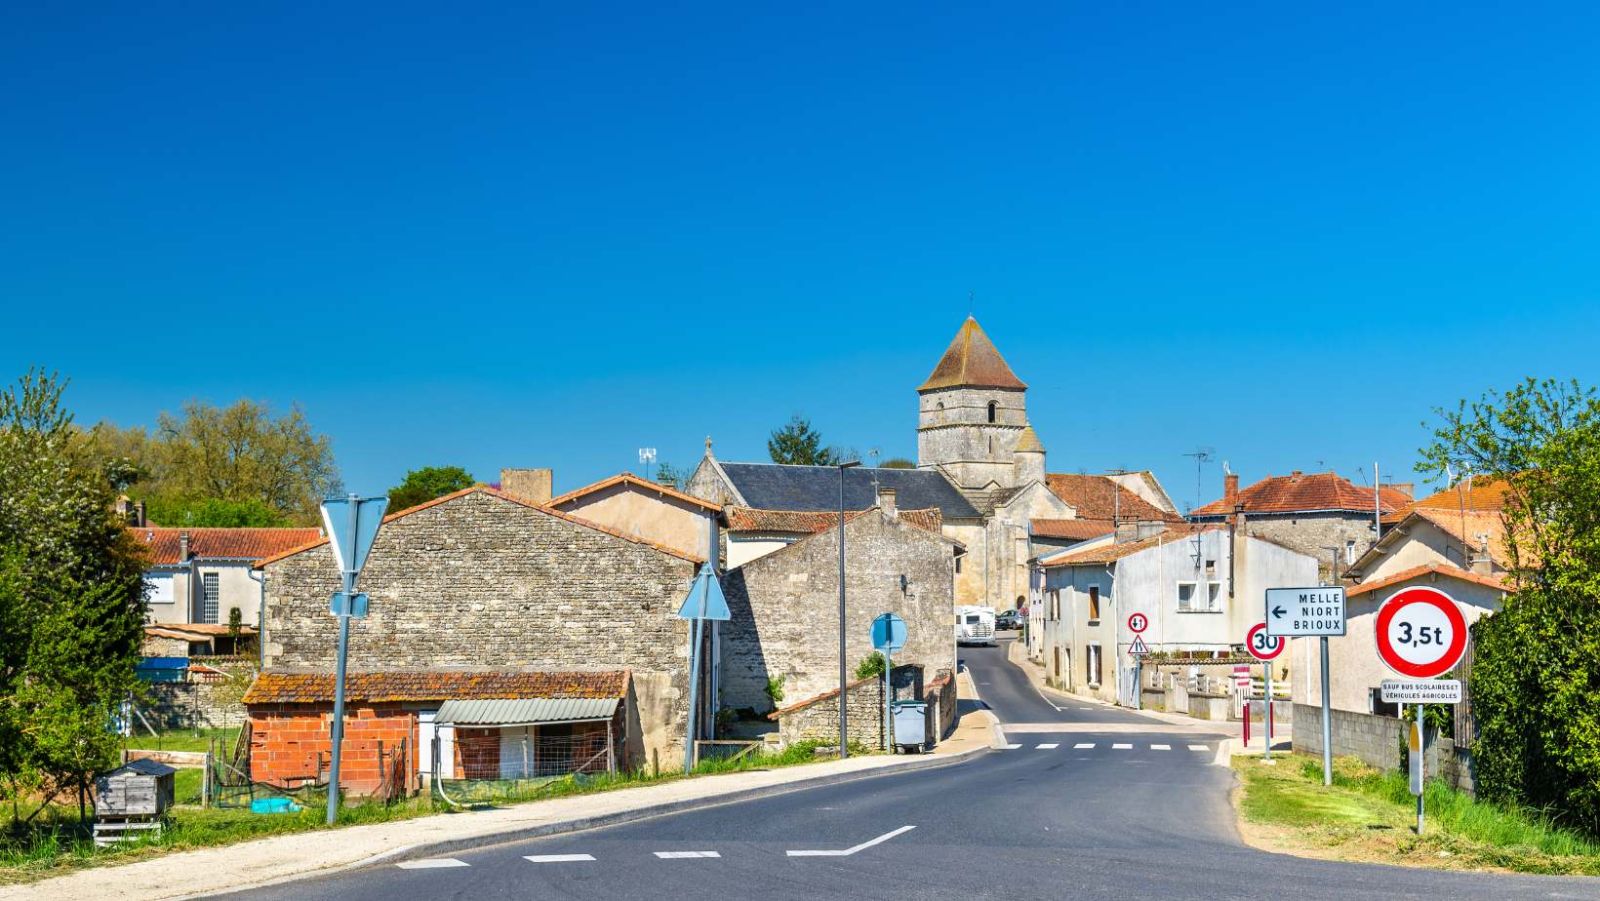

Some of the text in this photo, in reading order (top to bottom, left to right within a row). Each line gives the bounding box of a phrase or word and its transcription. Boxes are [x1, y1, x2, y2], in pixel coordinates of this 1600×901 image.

[1299, 594, 1339, 603] MELLE
[1302, 607, 1339, 616] NIORT
[1294, 620, 1340, 629] BRIOUX
[1398, 622, 1443, 648] 3,5t
[1254, 633, 1278, 650] 30
